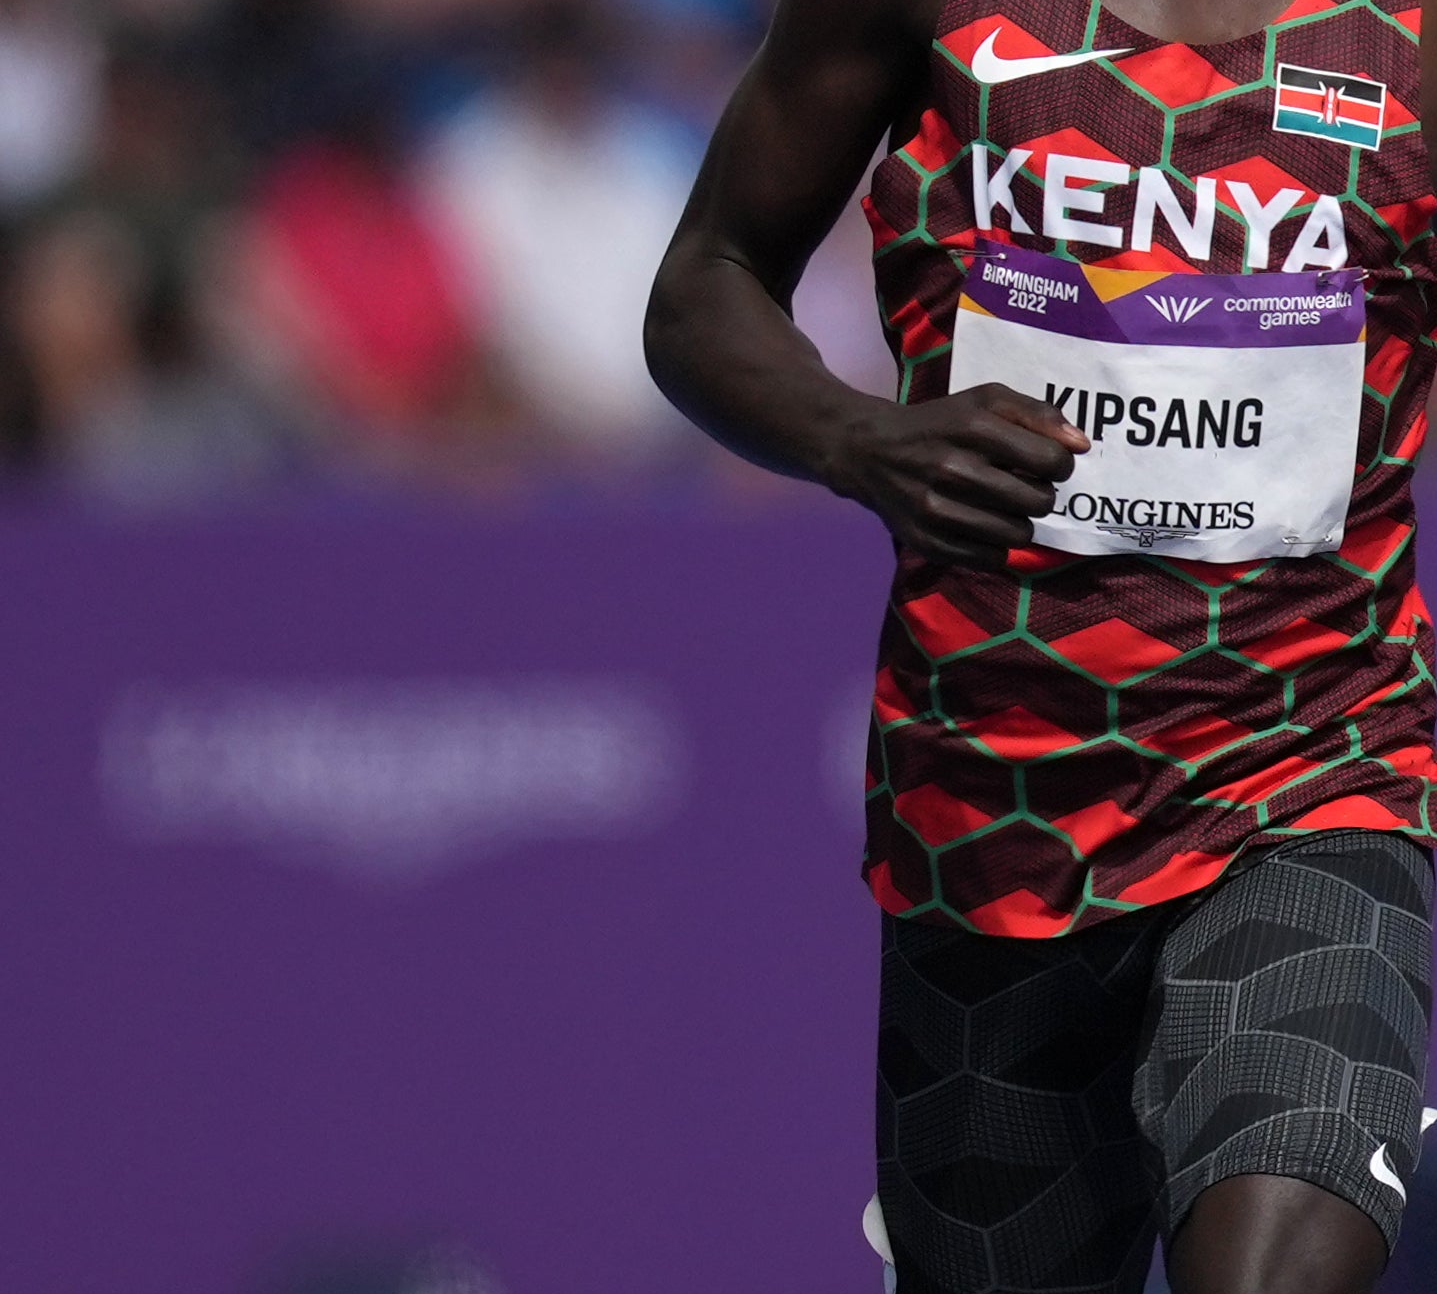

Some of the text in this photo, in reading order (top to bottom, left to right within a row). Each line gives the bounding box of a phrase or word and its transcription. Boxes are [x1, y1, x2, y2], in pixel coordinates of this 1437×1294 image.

[972, 143, 1349, 273] KENYA
[982, 263, 1079, 305] BIRMINGHAM
[1007, 289, 1048, 316] 2022
[1223, 291, 1353, 313] commonwealth
[1259, 310, 1321, 331] games
